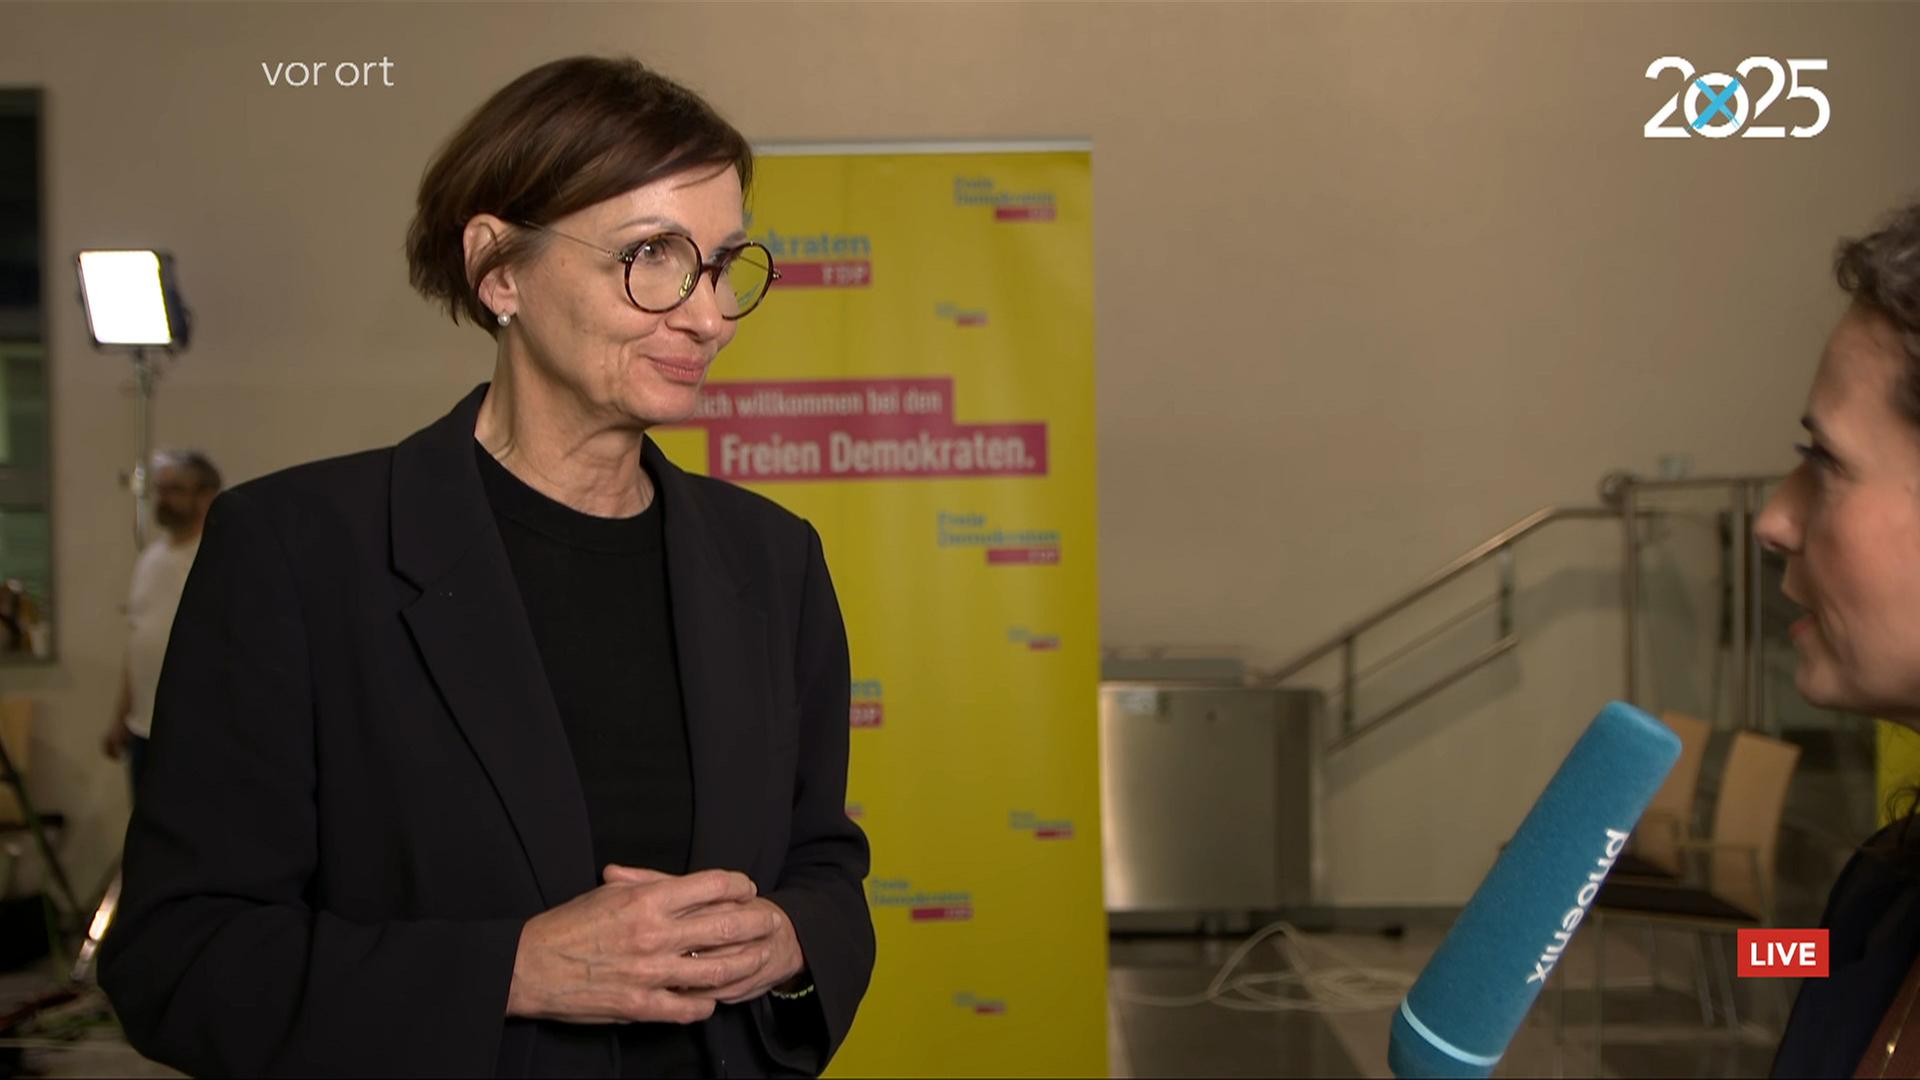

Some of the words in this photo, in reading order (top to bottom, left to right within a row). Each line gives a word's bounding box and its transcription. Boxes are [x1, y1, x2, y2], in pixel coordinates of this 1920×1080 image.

[736, 387, 864, 417] willkommen
[866, 384, 900, 415] bei
[903, 385, 944, 415] den
[721, 433, 821, 475] Freien
[829, 430, 1036, 472] Demokraten.
[1527, 828, 1630, 984] phoenix
